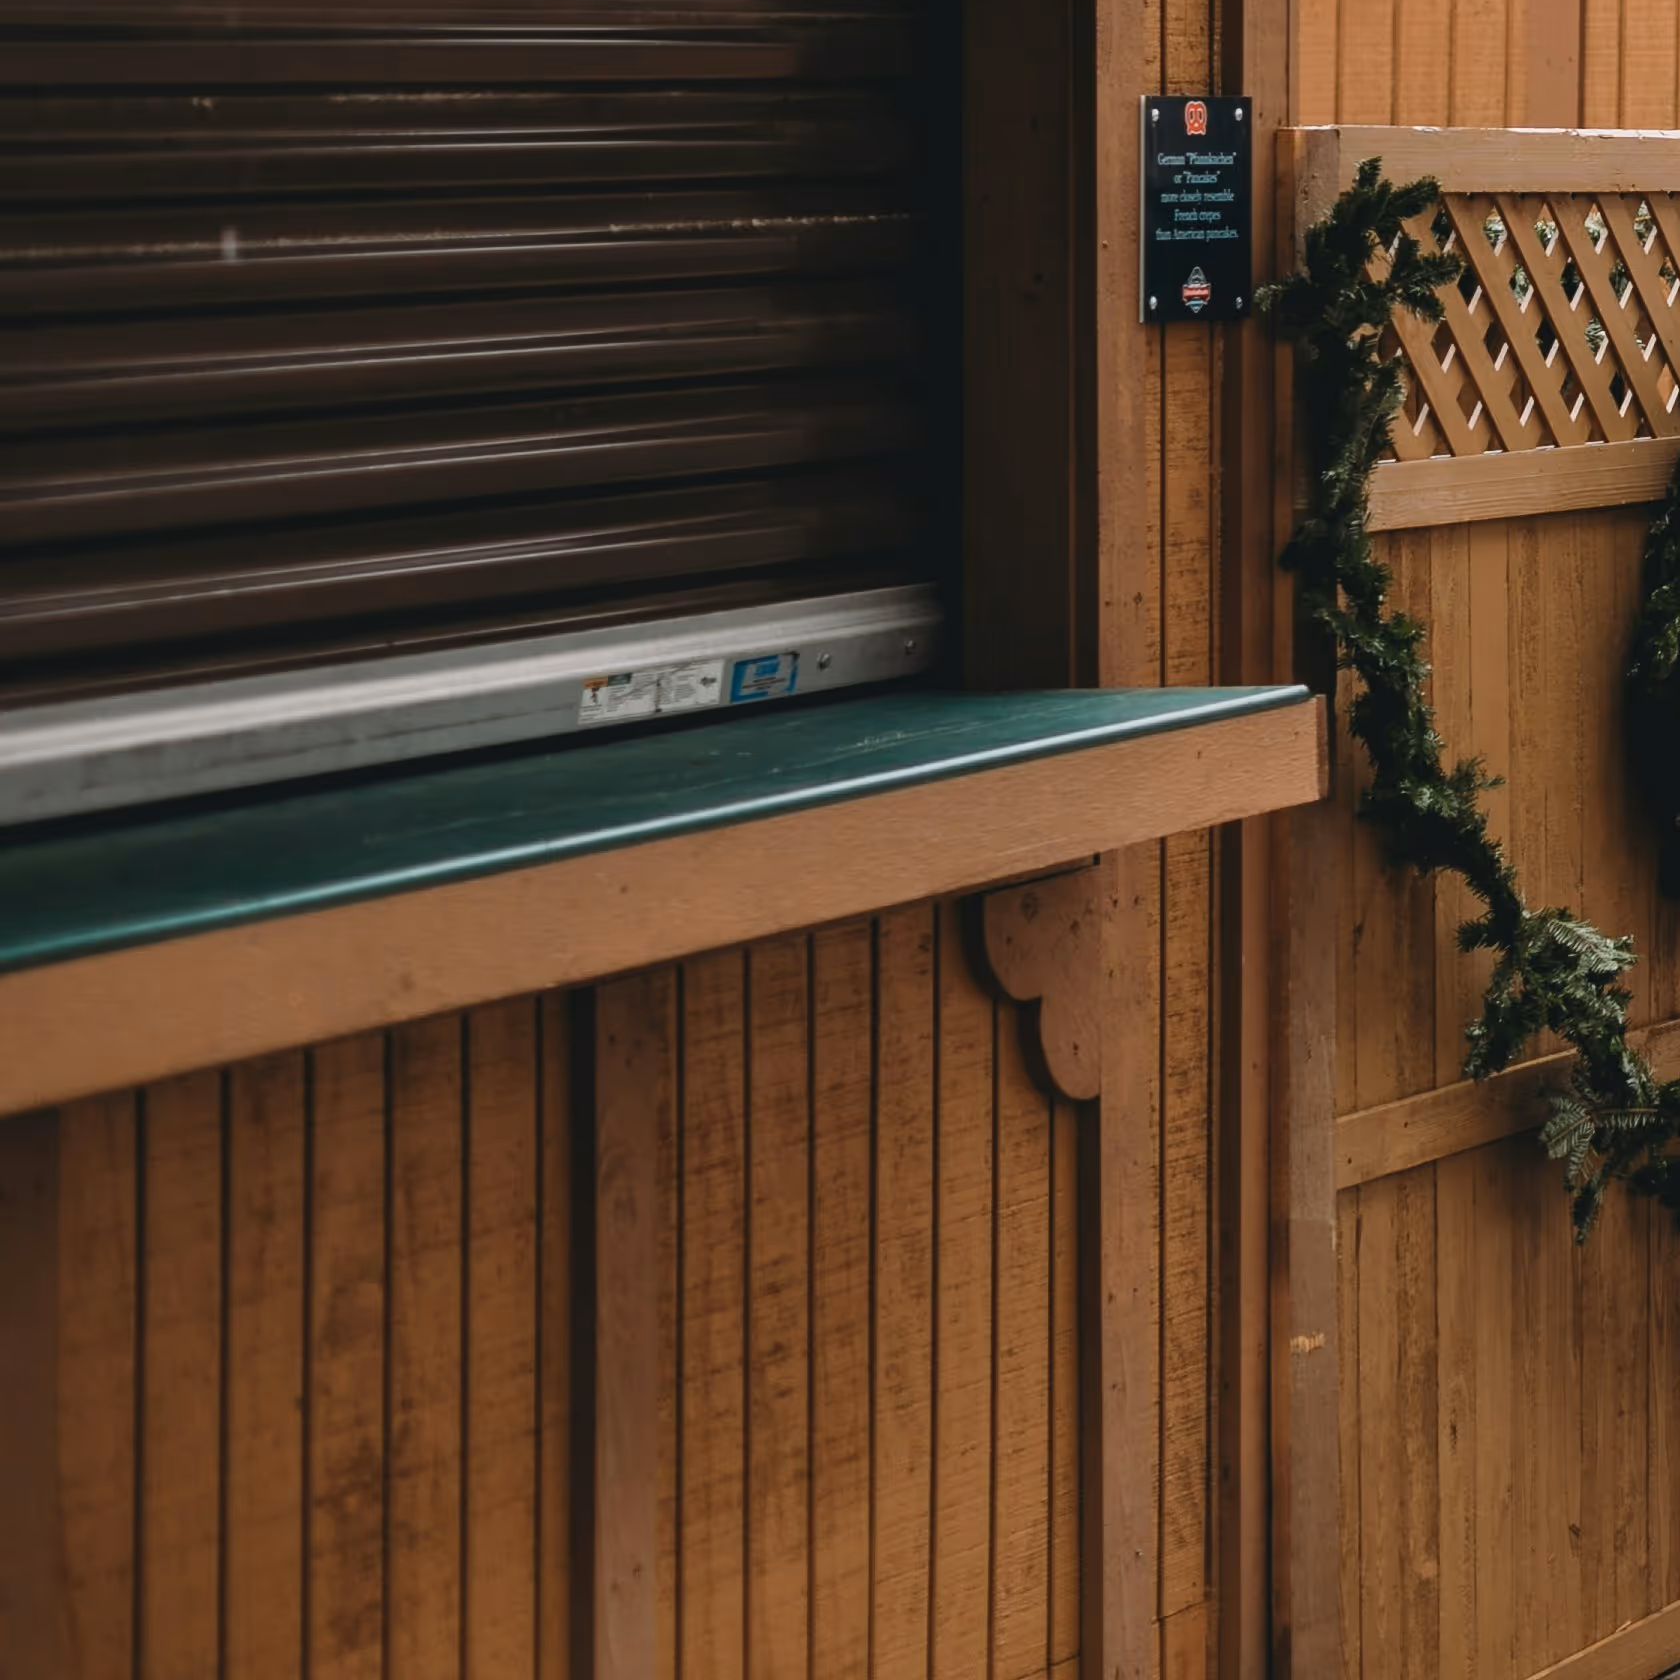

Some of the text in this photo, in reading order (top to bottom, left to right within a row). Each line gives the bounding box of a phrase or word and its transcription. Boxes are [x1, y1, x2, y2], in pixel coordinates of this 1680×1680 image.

[1158, 152, 1185, 165] German
[1161, 188, 1234, 205] more closely resemble
[1174, 208, 1197, 221] French
[1173, 228, 1204, 240] American
